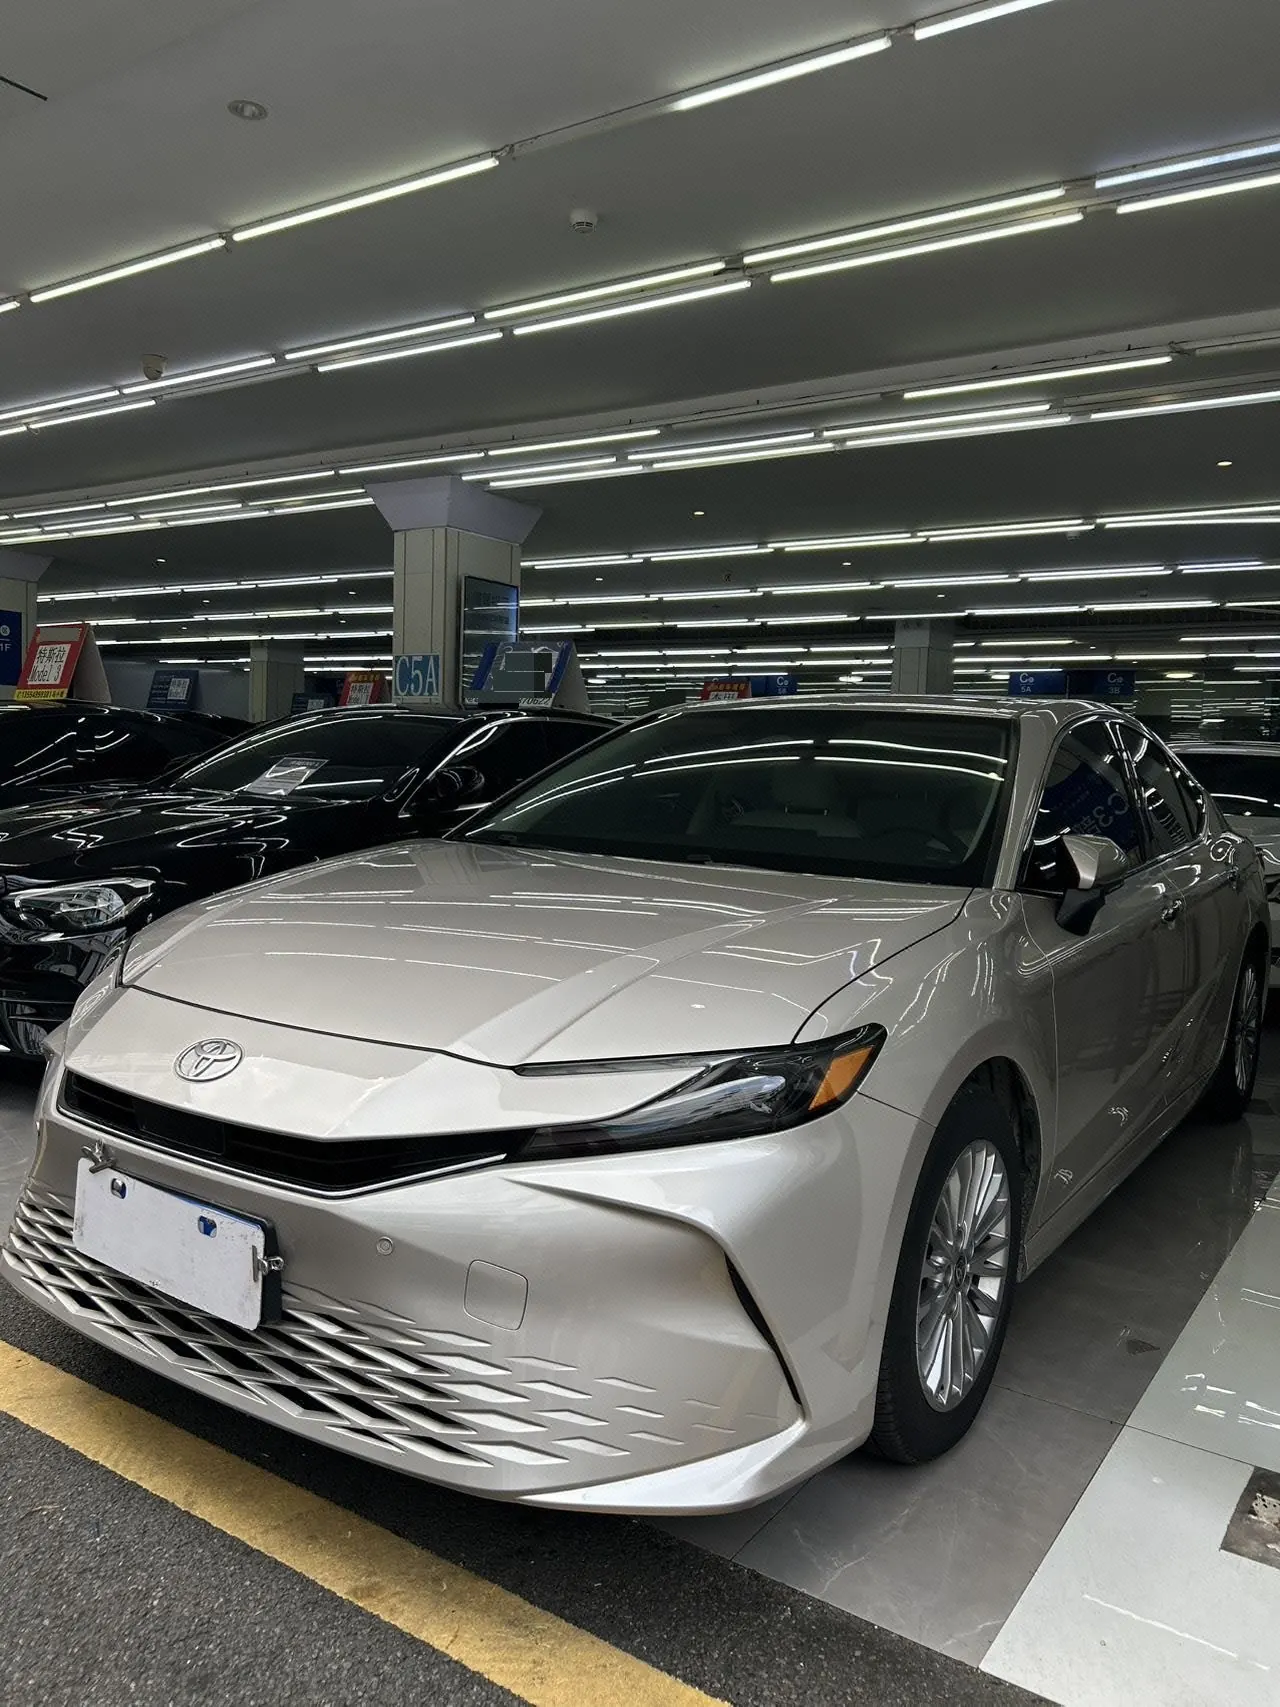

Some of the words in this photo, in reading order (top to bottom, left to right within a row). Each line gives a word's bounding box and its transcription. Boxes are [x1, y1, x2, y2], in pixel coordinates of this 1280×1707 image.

[38, 646, 67, 663] 特斯拉
[396, 656, 438, 696] C5A
